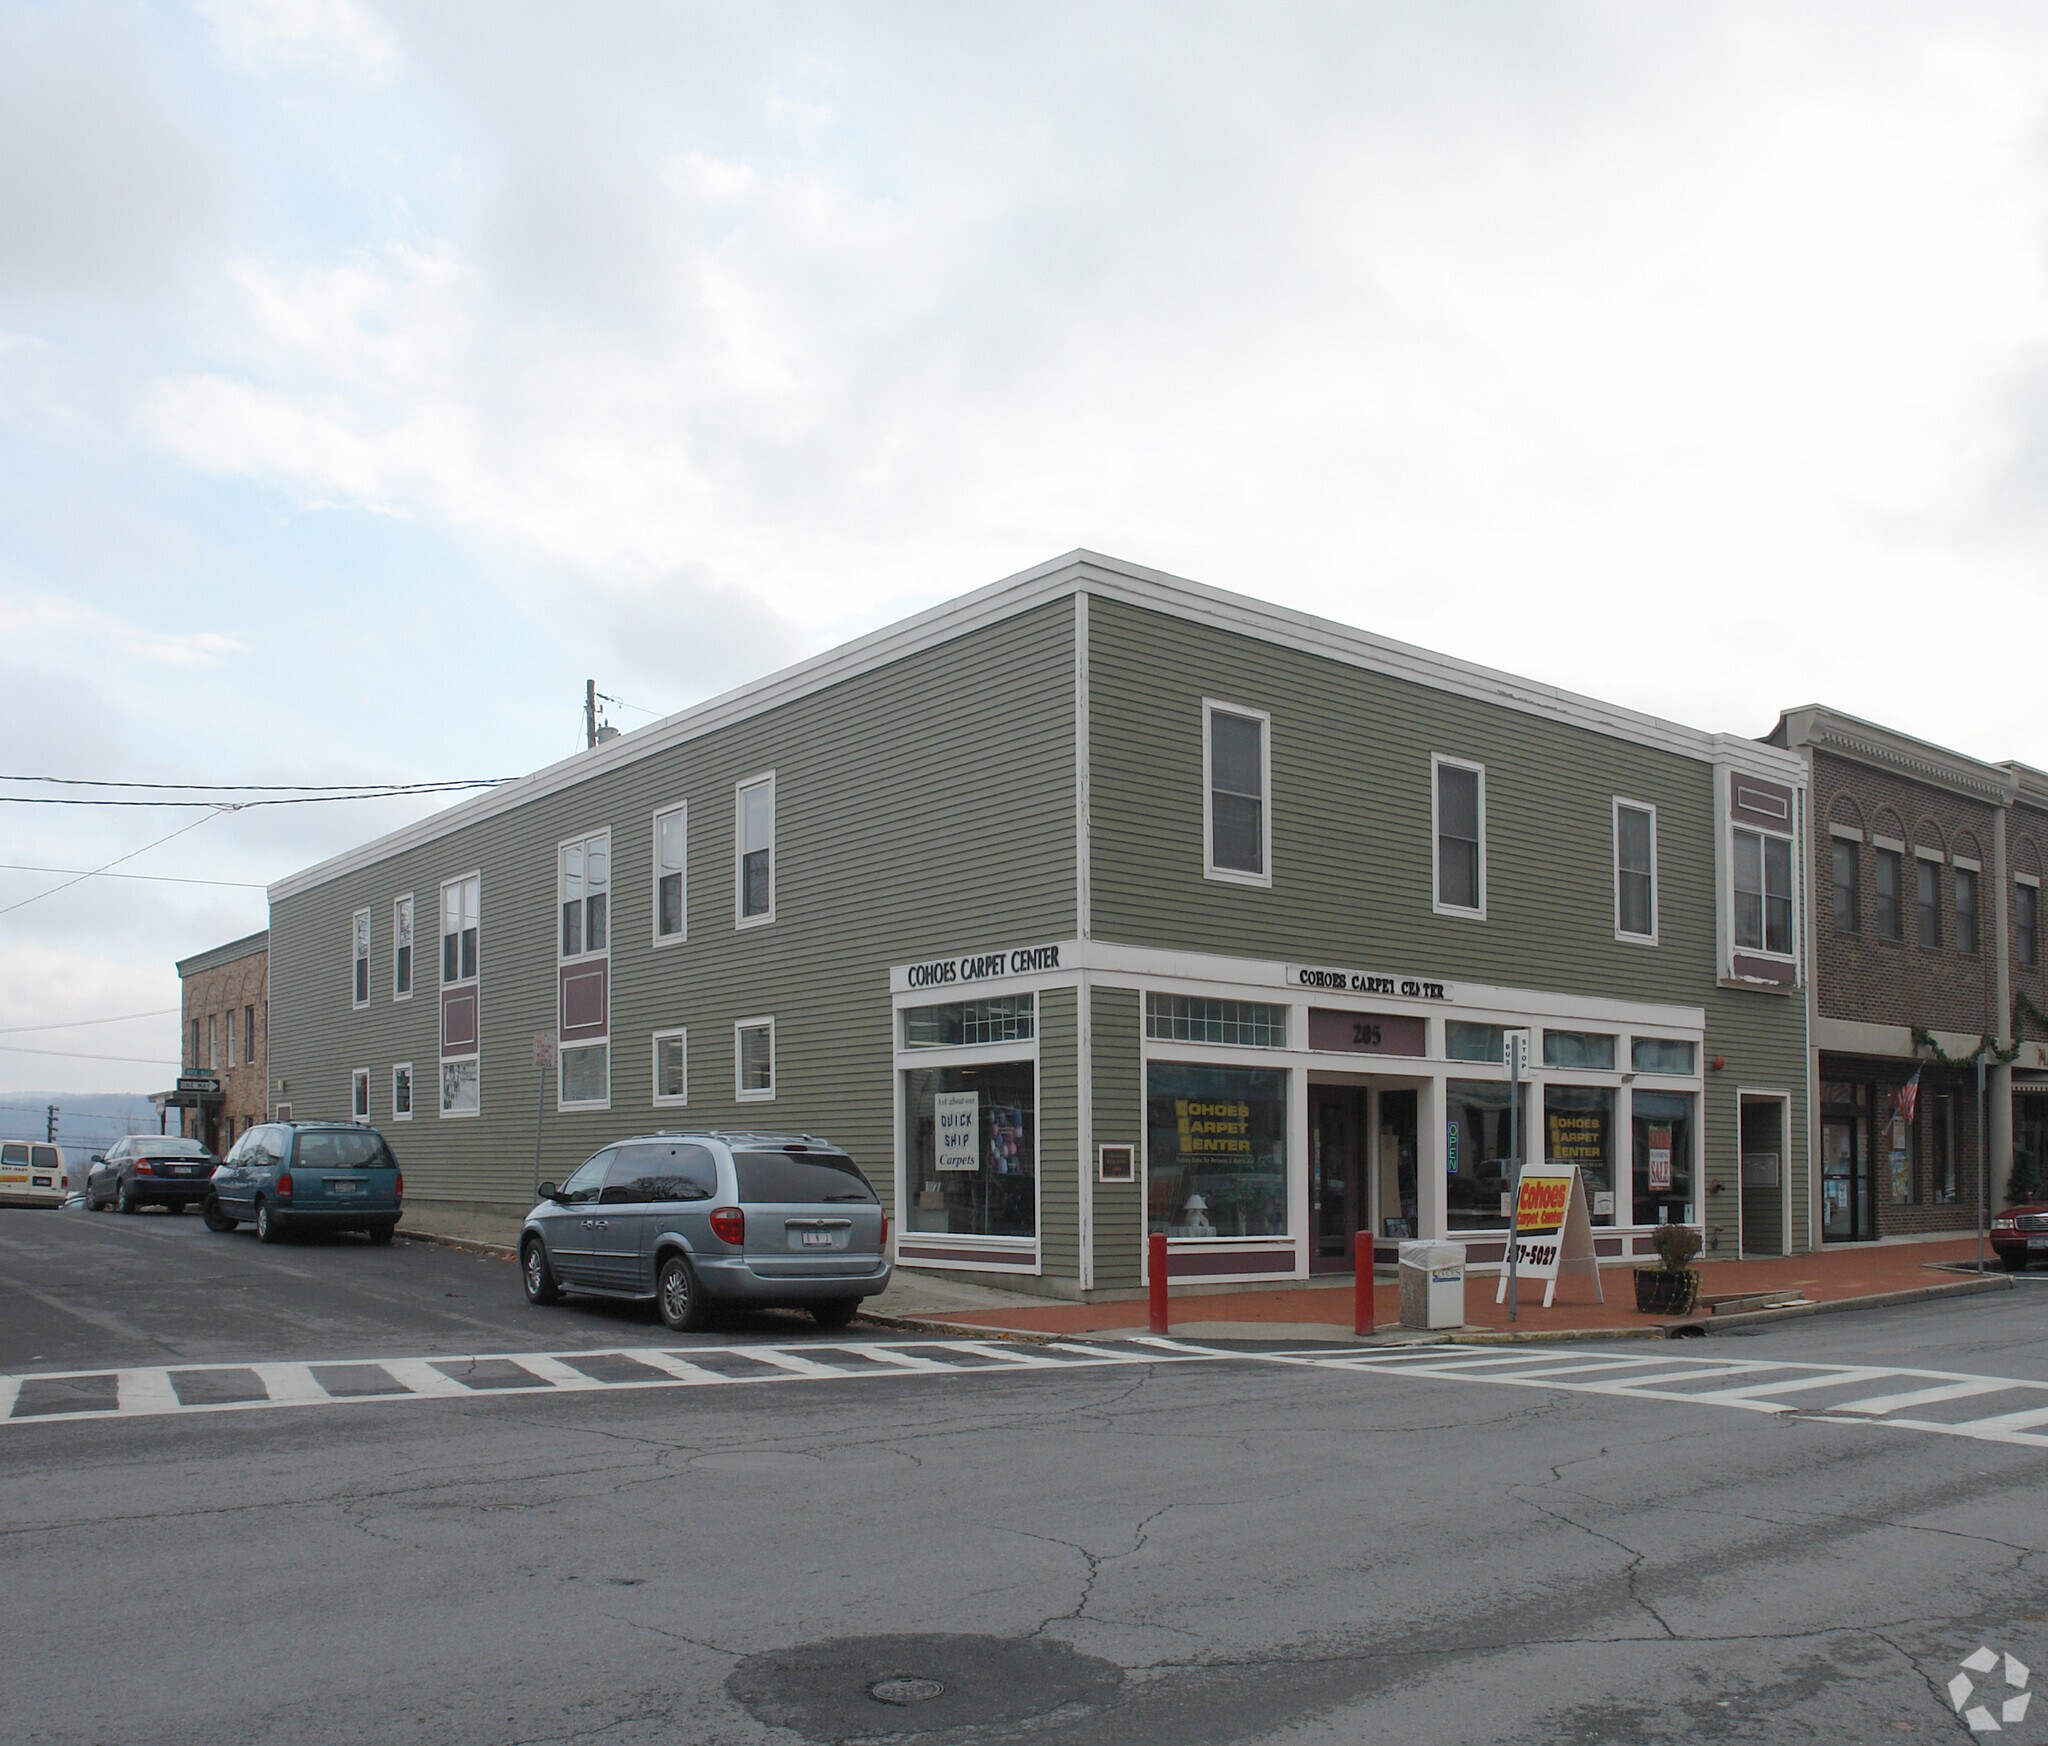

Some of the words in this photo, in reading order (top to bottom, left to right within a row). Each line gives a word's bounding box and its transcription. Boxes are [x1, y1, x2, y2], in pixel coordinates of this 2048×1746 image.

[908, 960, 957, 988] COHOES
[960, 953, 1006, 981] CARPET
[1011, 945, 1060, 973] CENTER
[1299, 969, 1346, 989] COHOES
[1351, 975, 1395, 994] CARPET
[1352, 1022, 1382, 1046] 205
[941, 1113, 972, 1127] QUICK
[944, 1134, 968, 1147] SHIP
[1449, 1124, 1457, 1170] OPEN
[940, 1154, 975, 1168] Carpets
[1651, 1161, 1669, 1183] SALE
[1520, 1181, 1566, 1210] Cohoes
